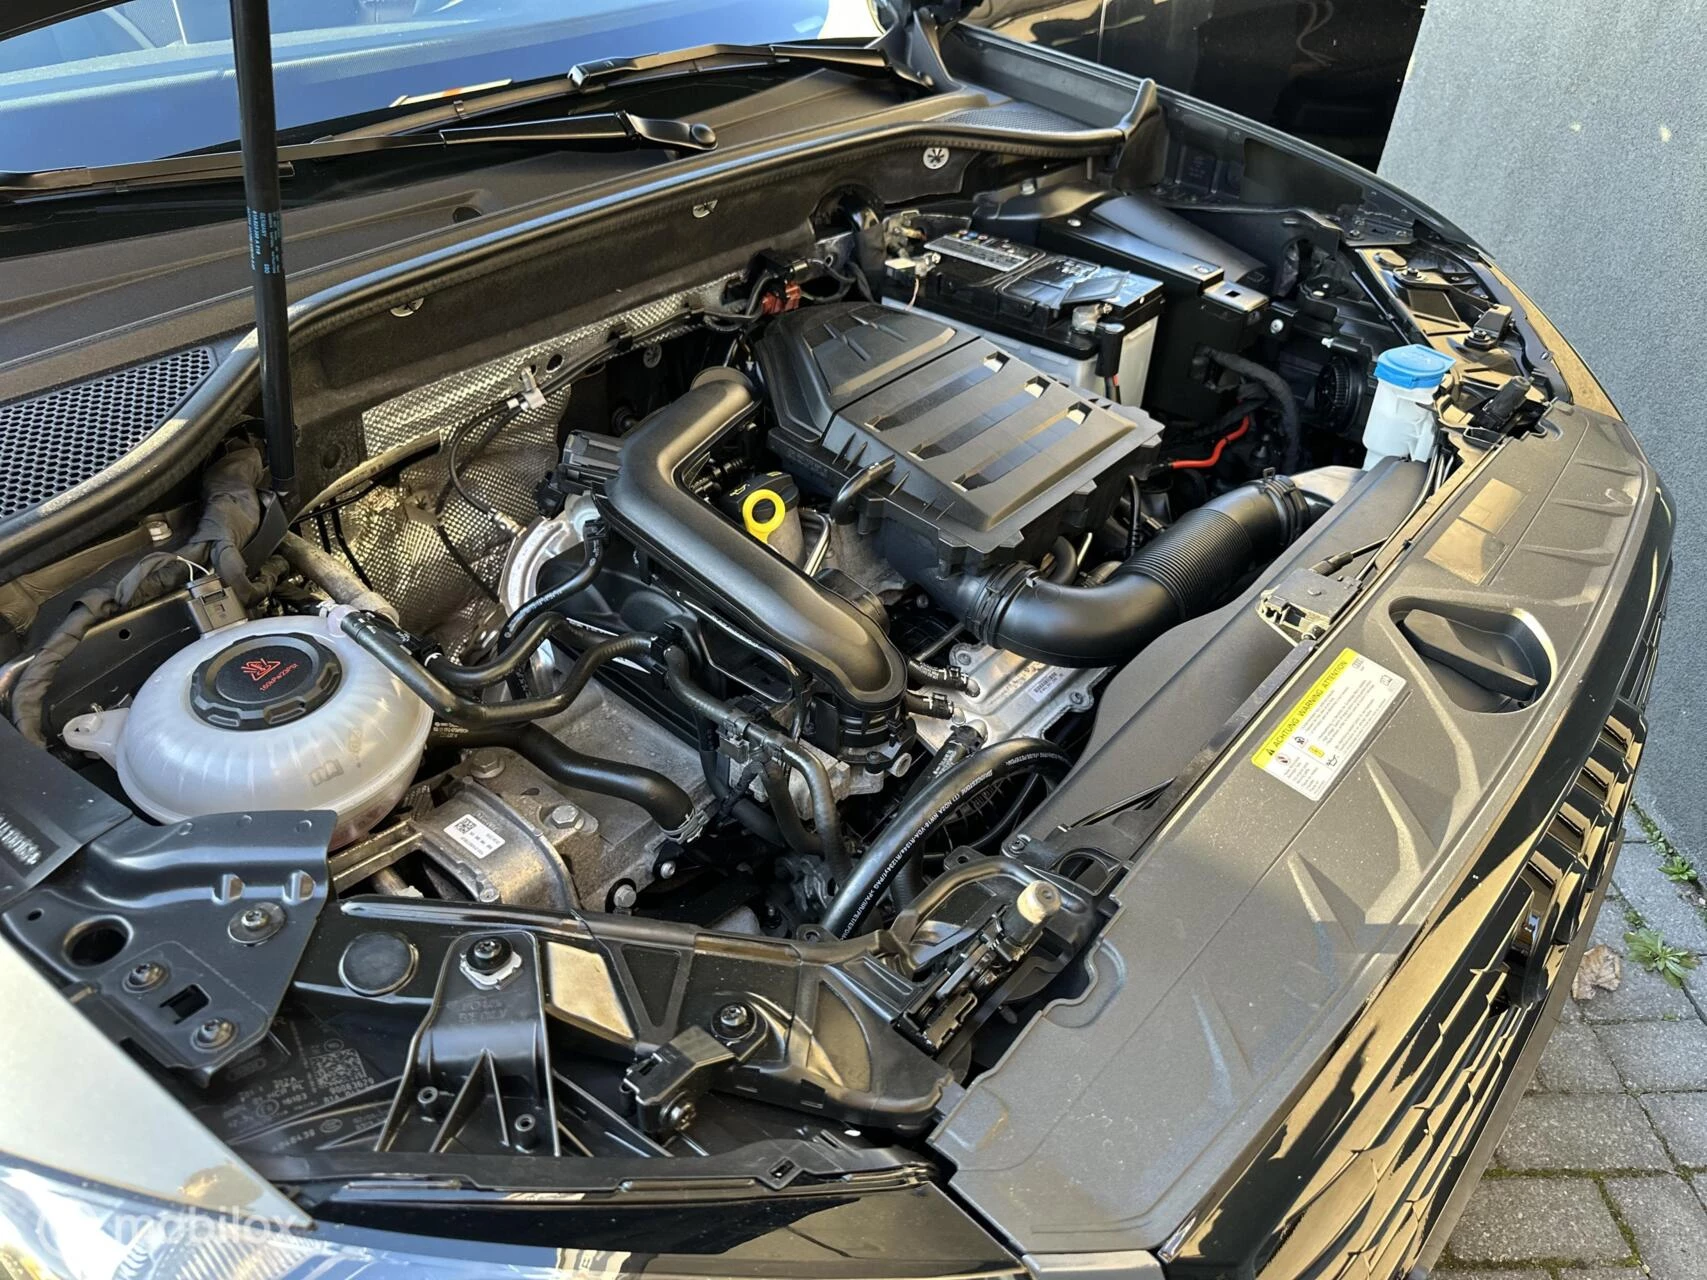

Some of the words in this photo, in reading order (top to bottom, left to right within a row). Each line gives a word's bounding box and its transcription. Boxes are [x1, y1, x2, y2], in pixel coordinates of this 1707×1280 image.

[1273, 718, 1300, 747] ACHTUNG
[1298, 688, 1323, 718] WARNING
[1322, 660, 1347, 688] ATTENTION
